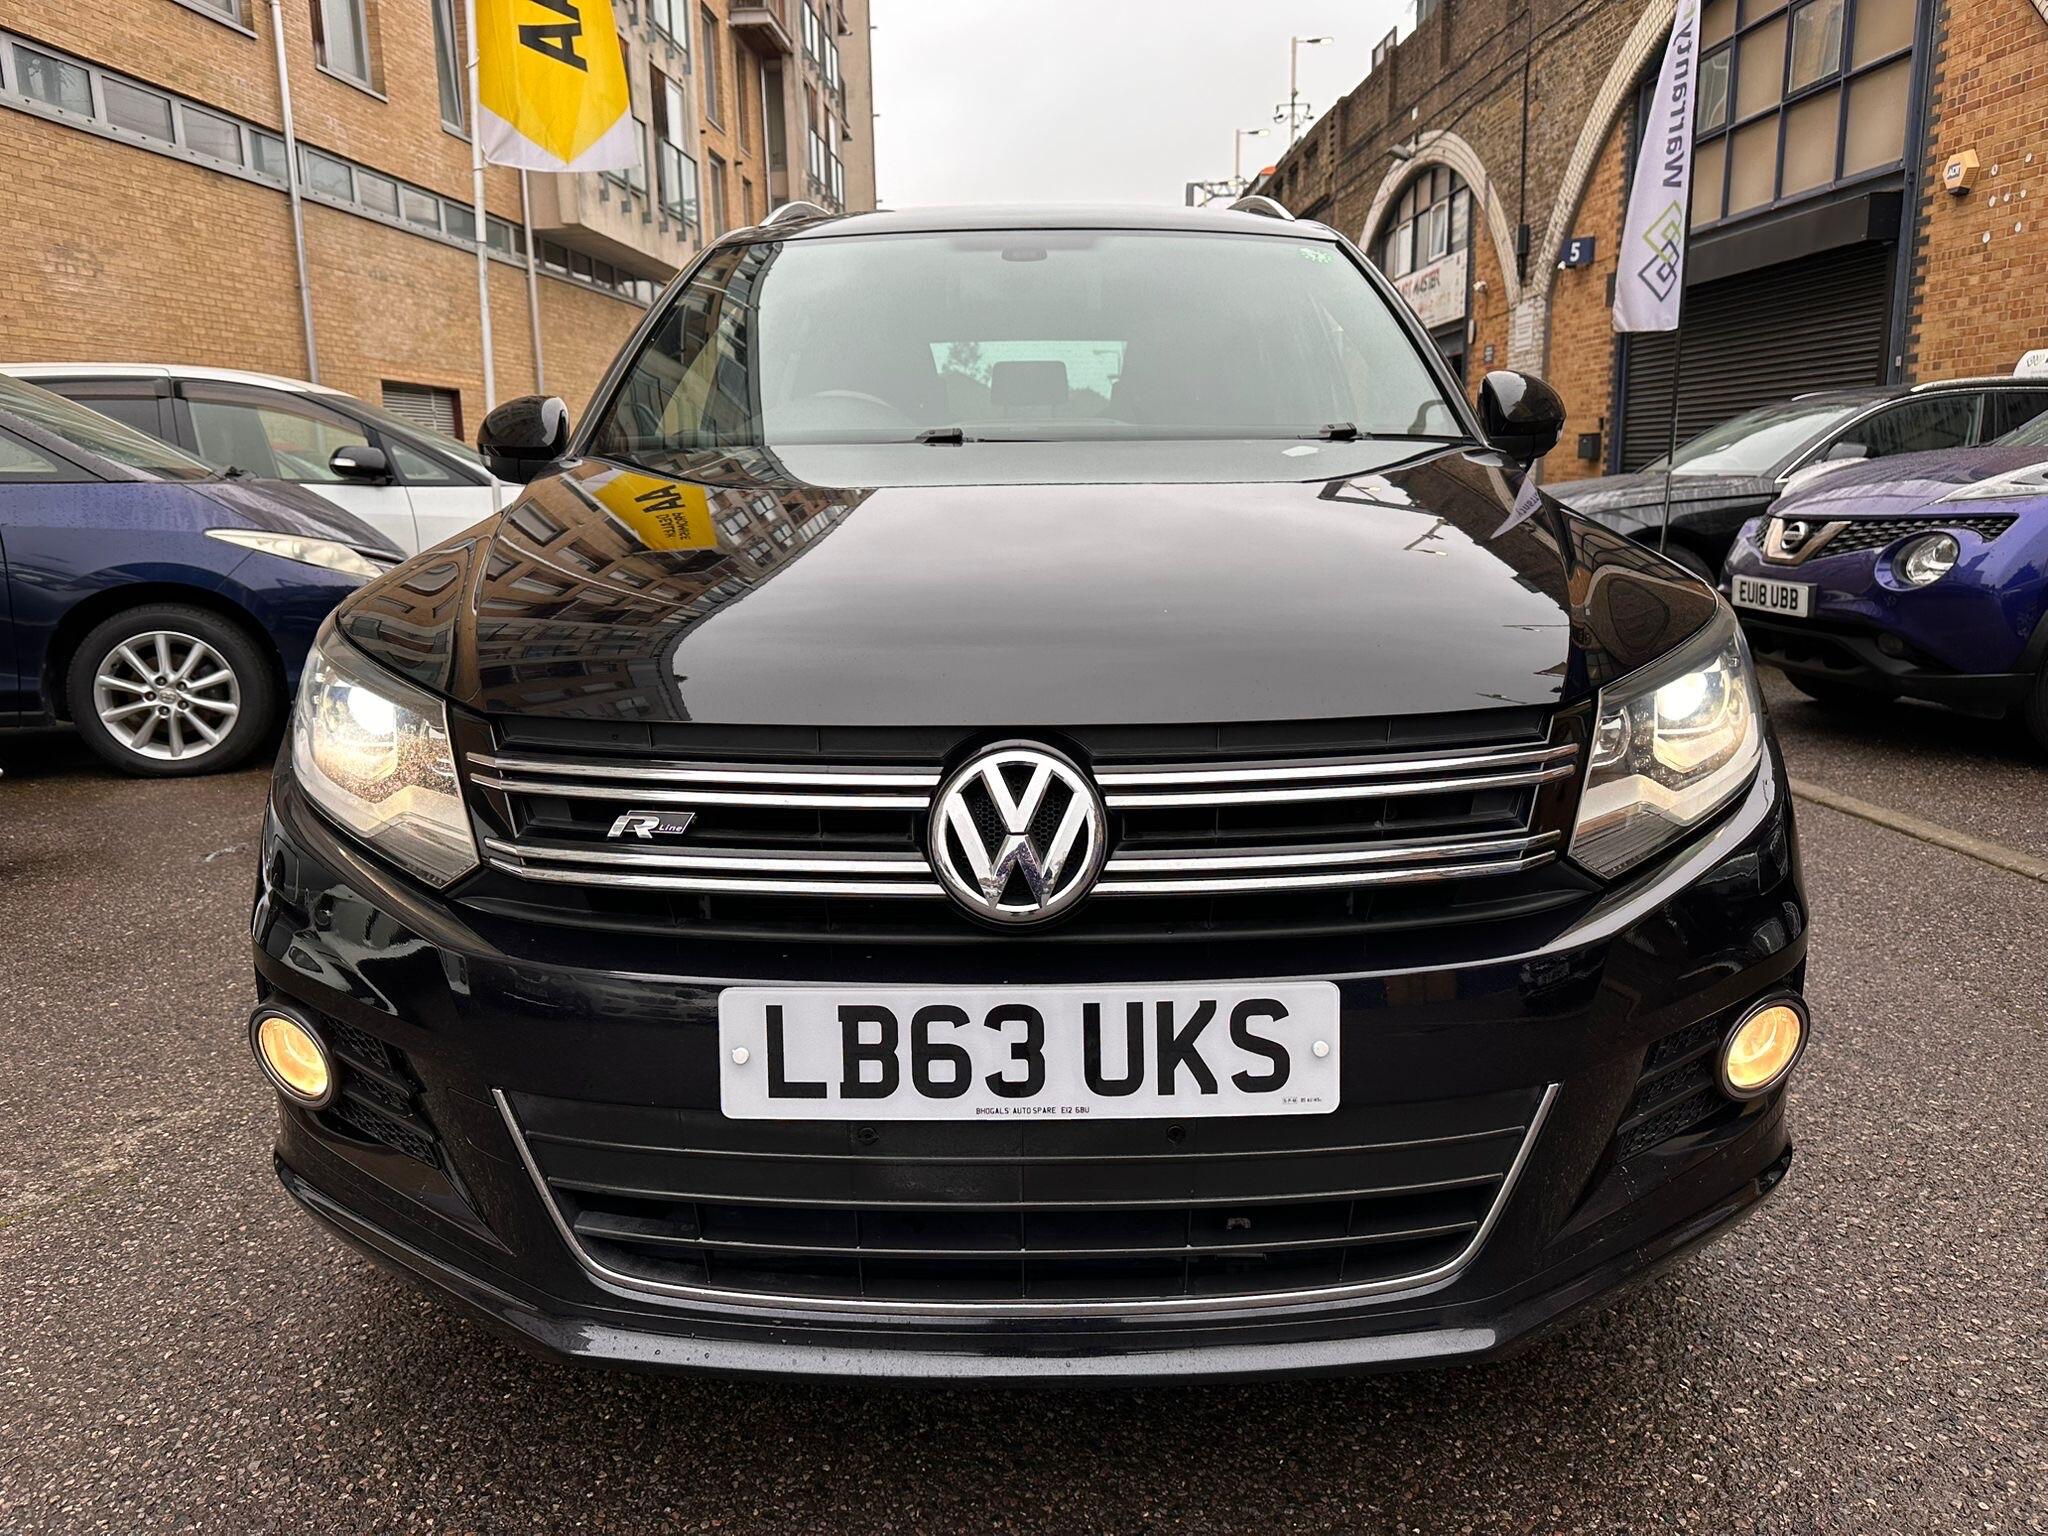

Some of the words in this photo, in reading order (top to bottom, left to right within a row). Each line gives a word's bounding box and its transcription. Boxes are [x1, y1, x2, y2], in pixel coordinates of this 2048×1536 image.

[1570, 242, 1581, 261] 5
[1739, 581, 1767, 605] EU18
[1770, 585, 1798, 610] UBB
[607, 815, 660, 839] R
[658, 823, 683, 832] Line
[940, 750, 1093, 910] VW
[766, 1004, 1045, 1099] LB63
[1082, 998, 1291, 1096] UKS
